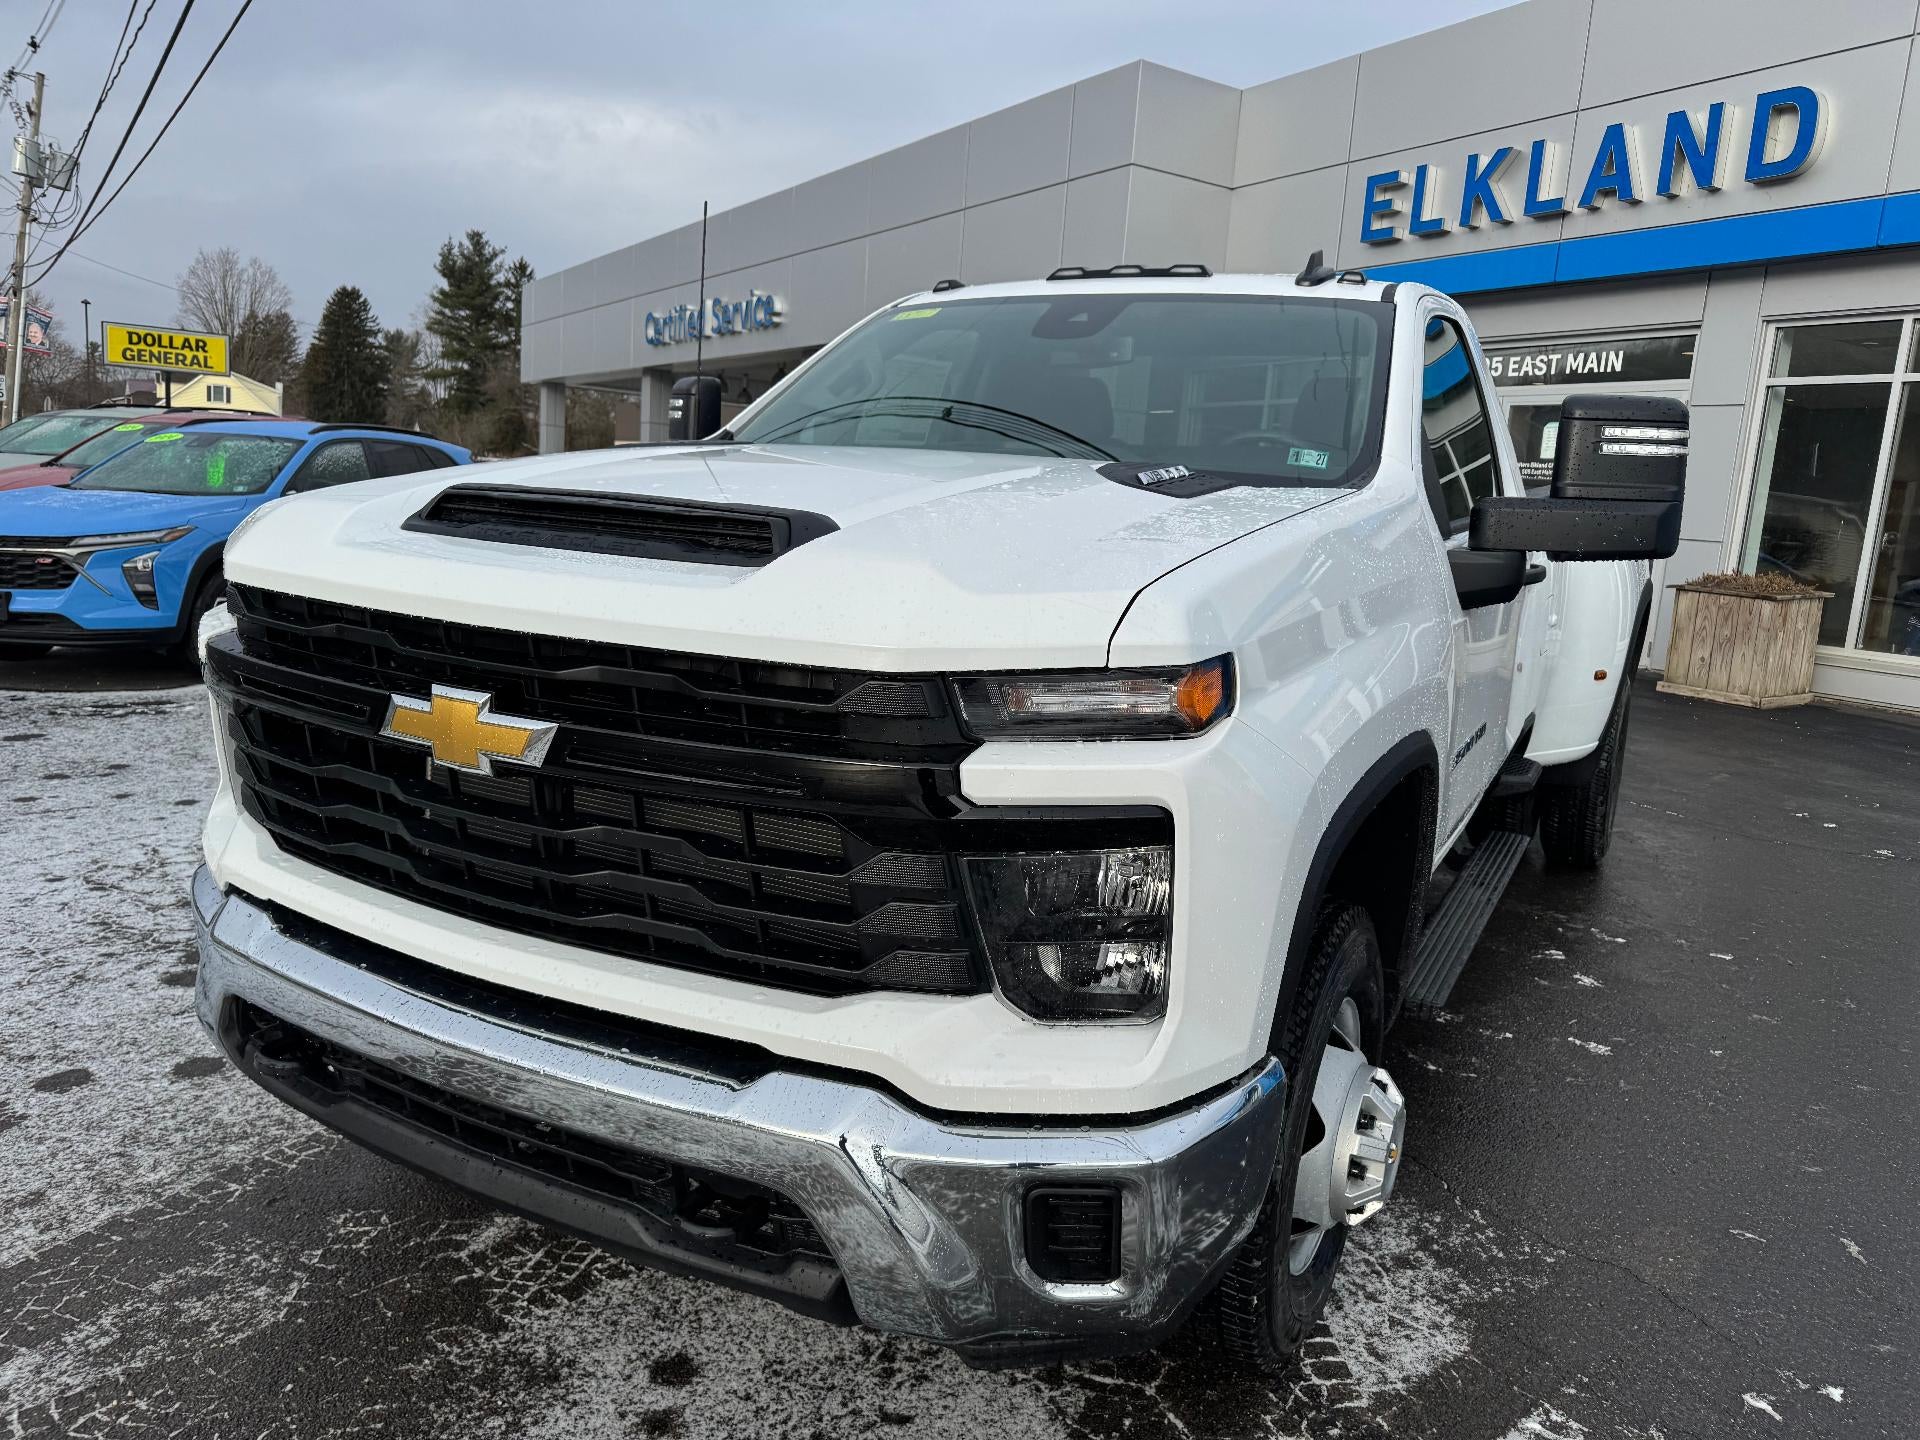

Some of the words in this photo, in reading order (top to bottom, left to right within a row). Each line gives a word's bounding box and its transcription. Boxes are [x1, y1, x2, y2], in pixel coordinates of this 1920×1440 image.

[1360, 86, 1824, 244] ELKLAND
[645, 304, 706, 345] Certified
[711, 289, 776, 334] Service
[126, 330, 209, 353] DOLLAR
[121, 347, 214, 369] GENERAL
[1507, 353, 1562, 377] EAST
[1565, 350, 1624, 375] MAIN
[1315, 453, 1327, 466] 27
